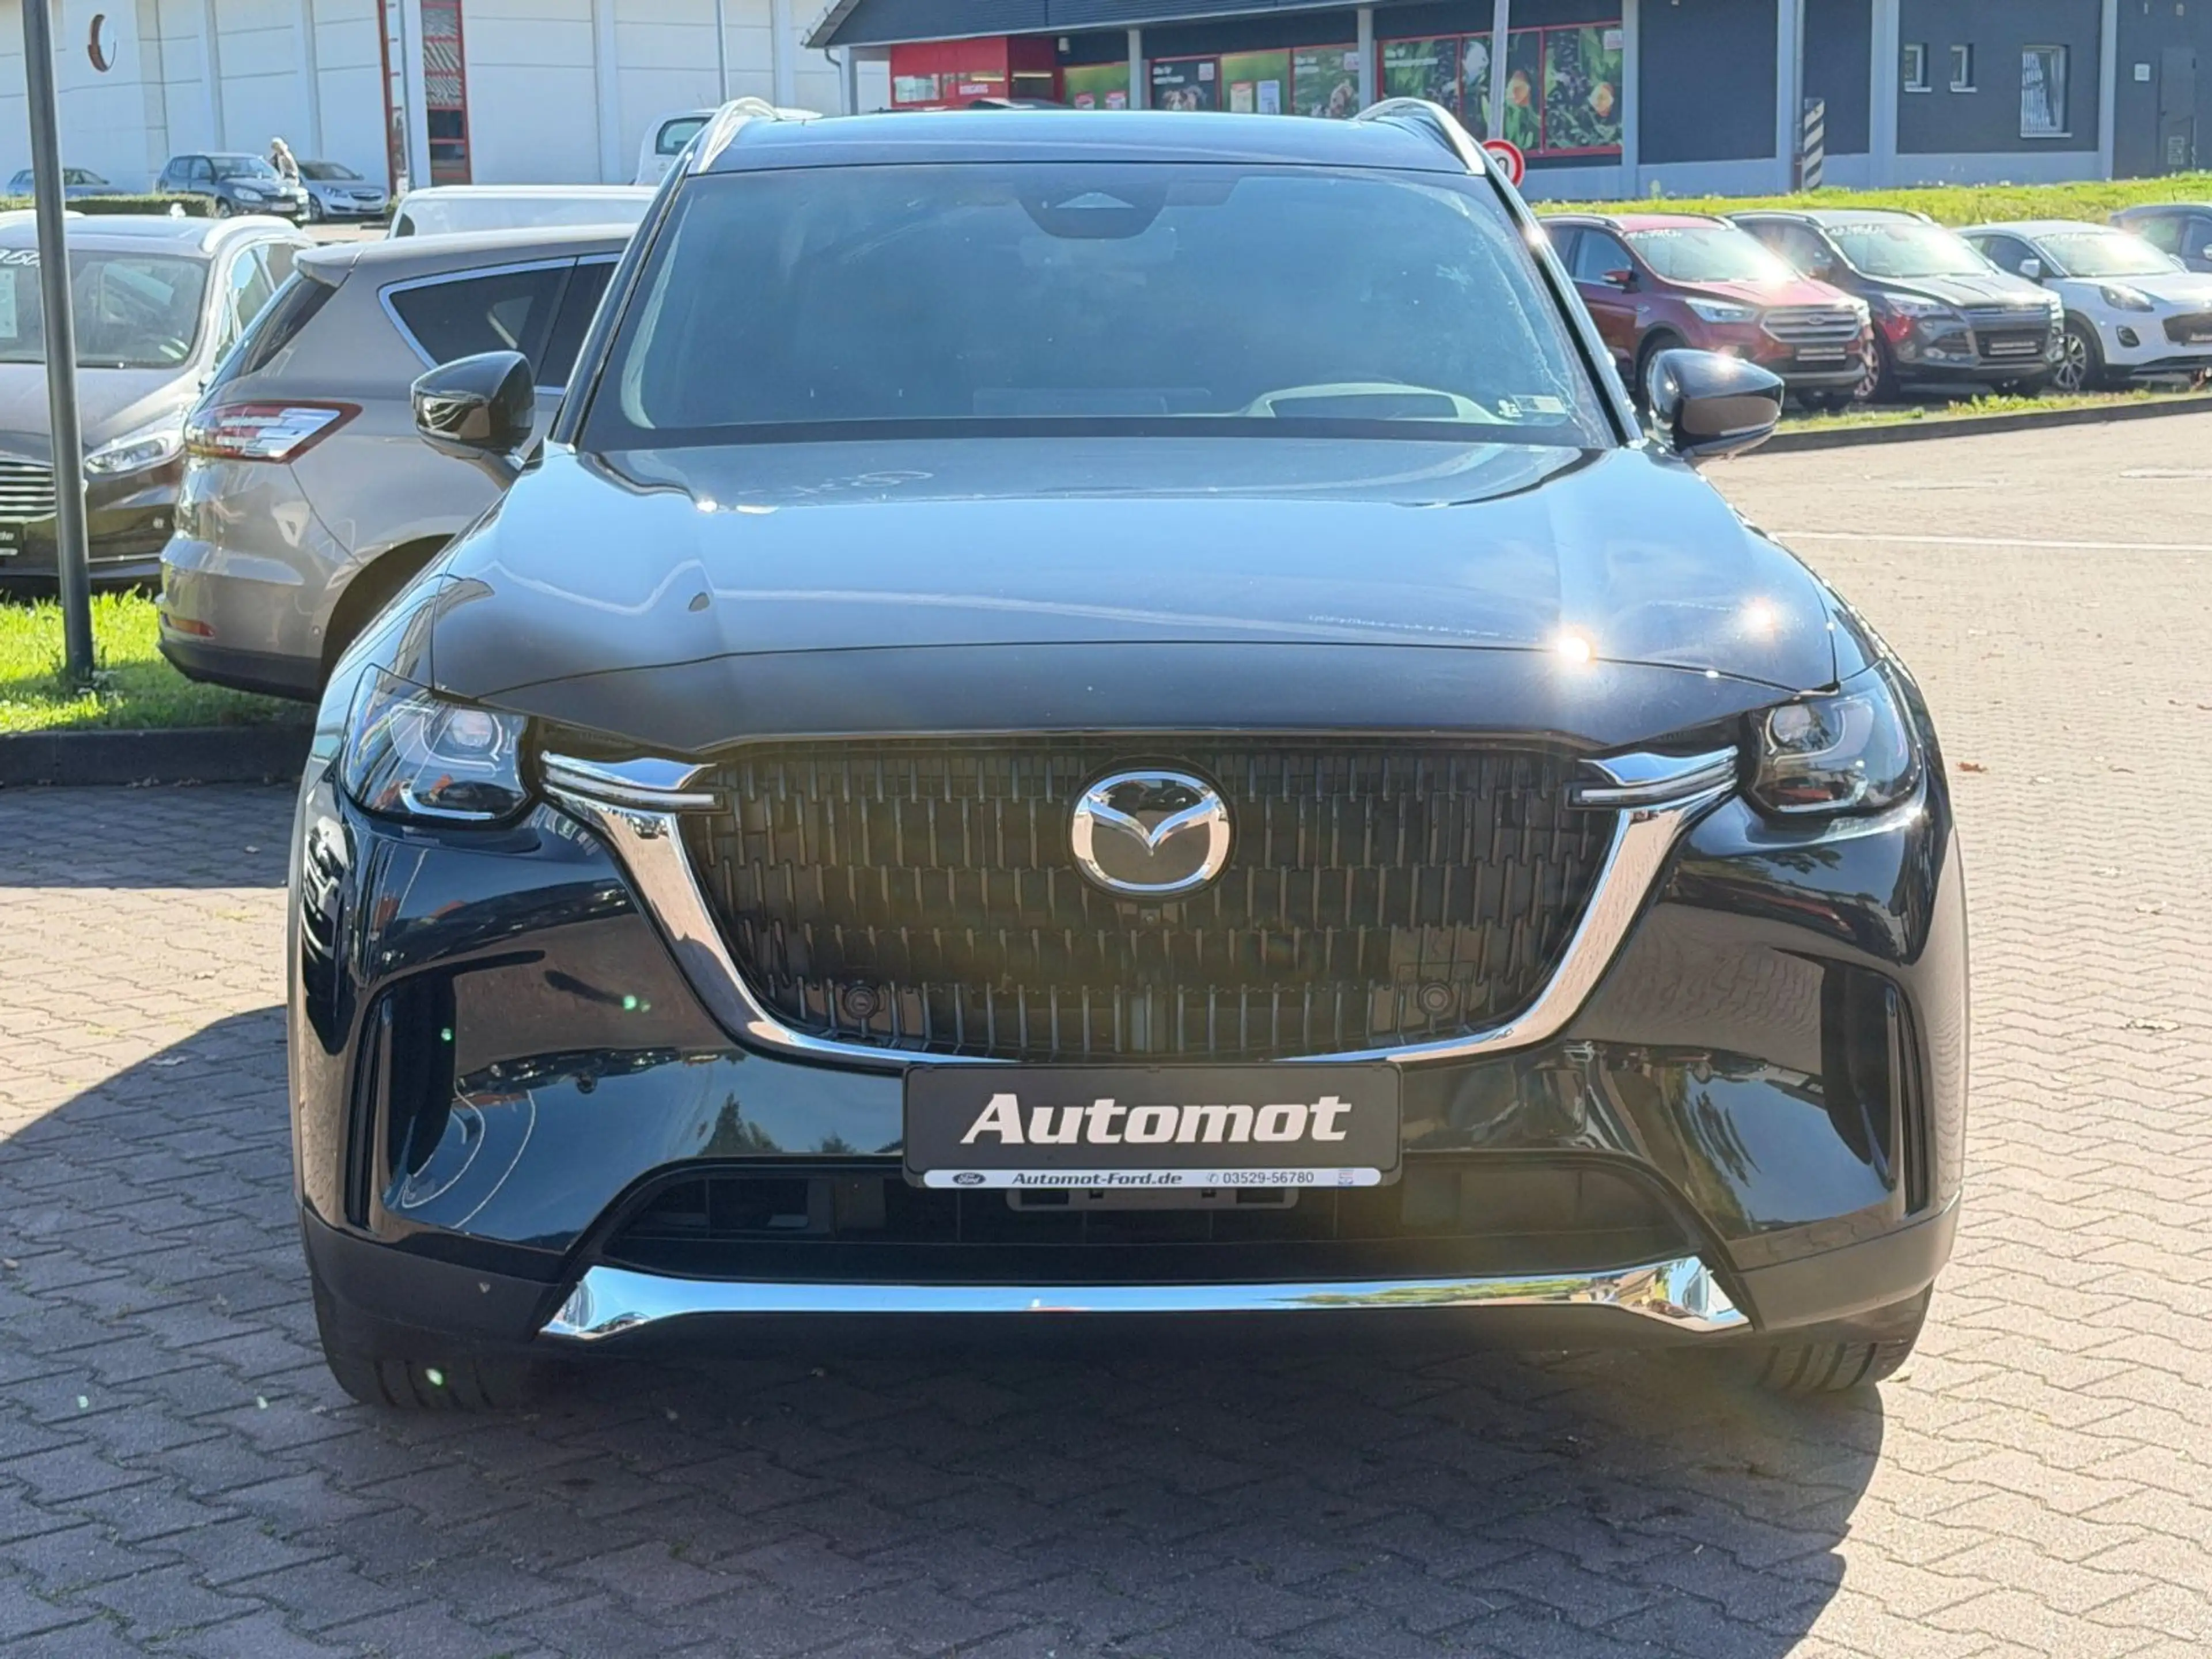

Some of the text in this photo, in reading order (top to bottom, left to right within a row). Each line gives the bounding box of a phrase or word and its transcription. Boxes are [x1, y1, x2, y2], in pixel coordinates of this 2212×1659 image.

[960, 1093, 1352, 1144] Automot
[1012, 1172, 1183, 1184] Automot-Ford.de
[1222, 1171, 1315, 1184] 03529-56780
